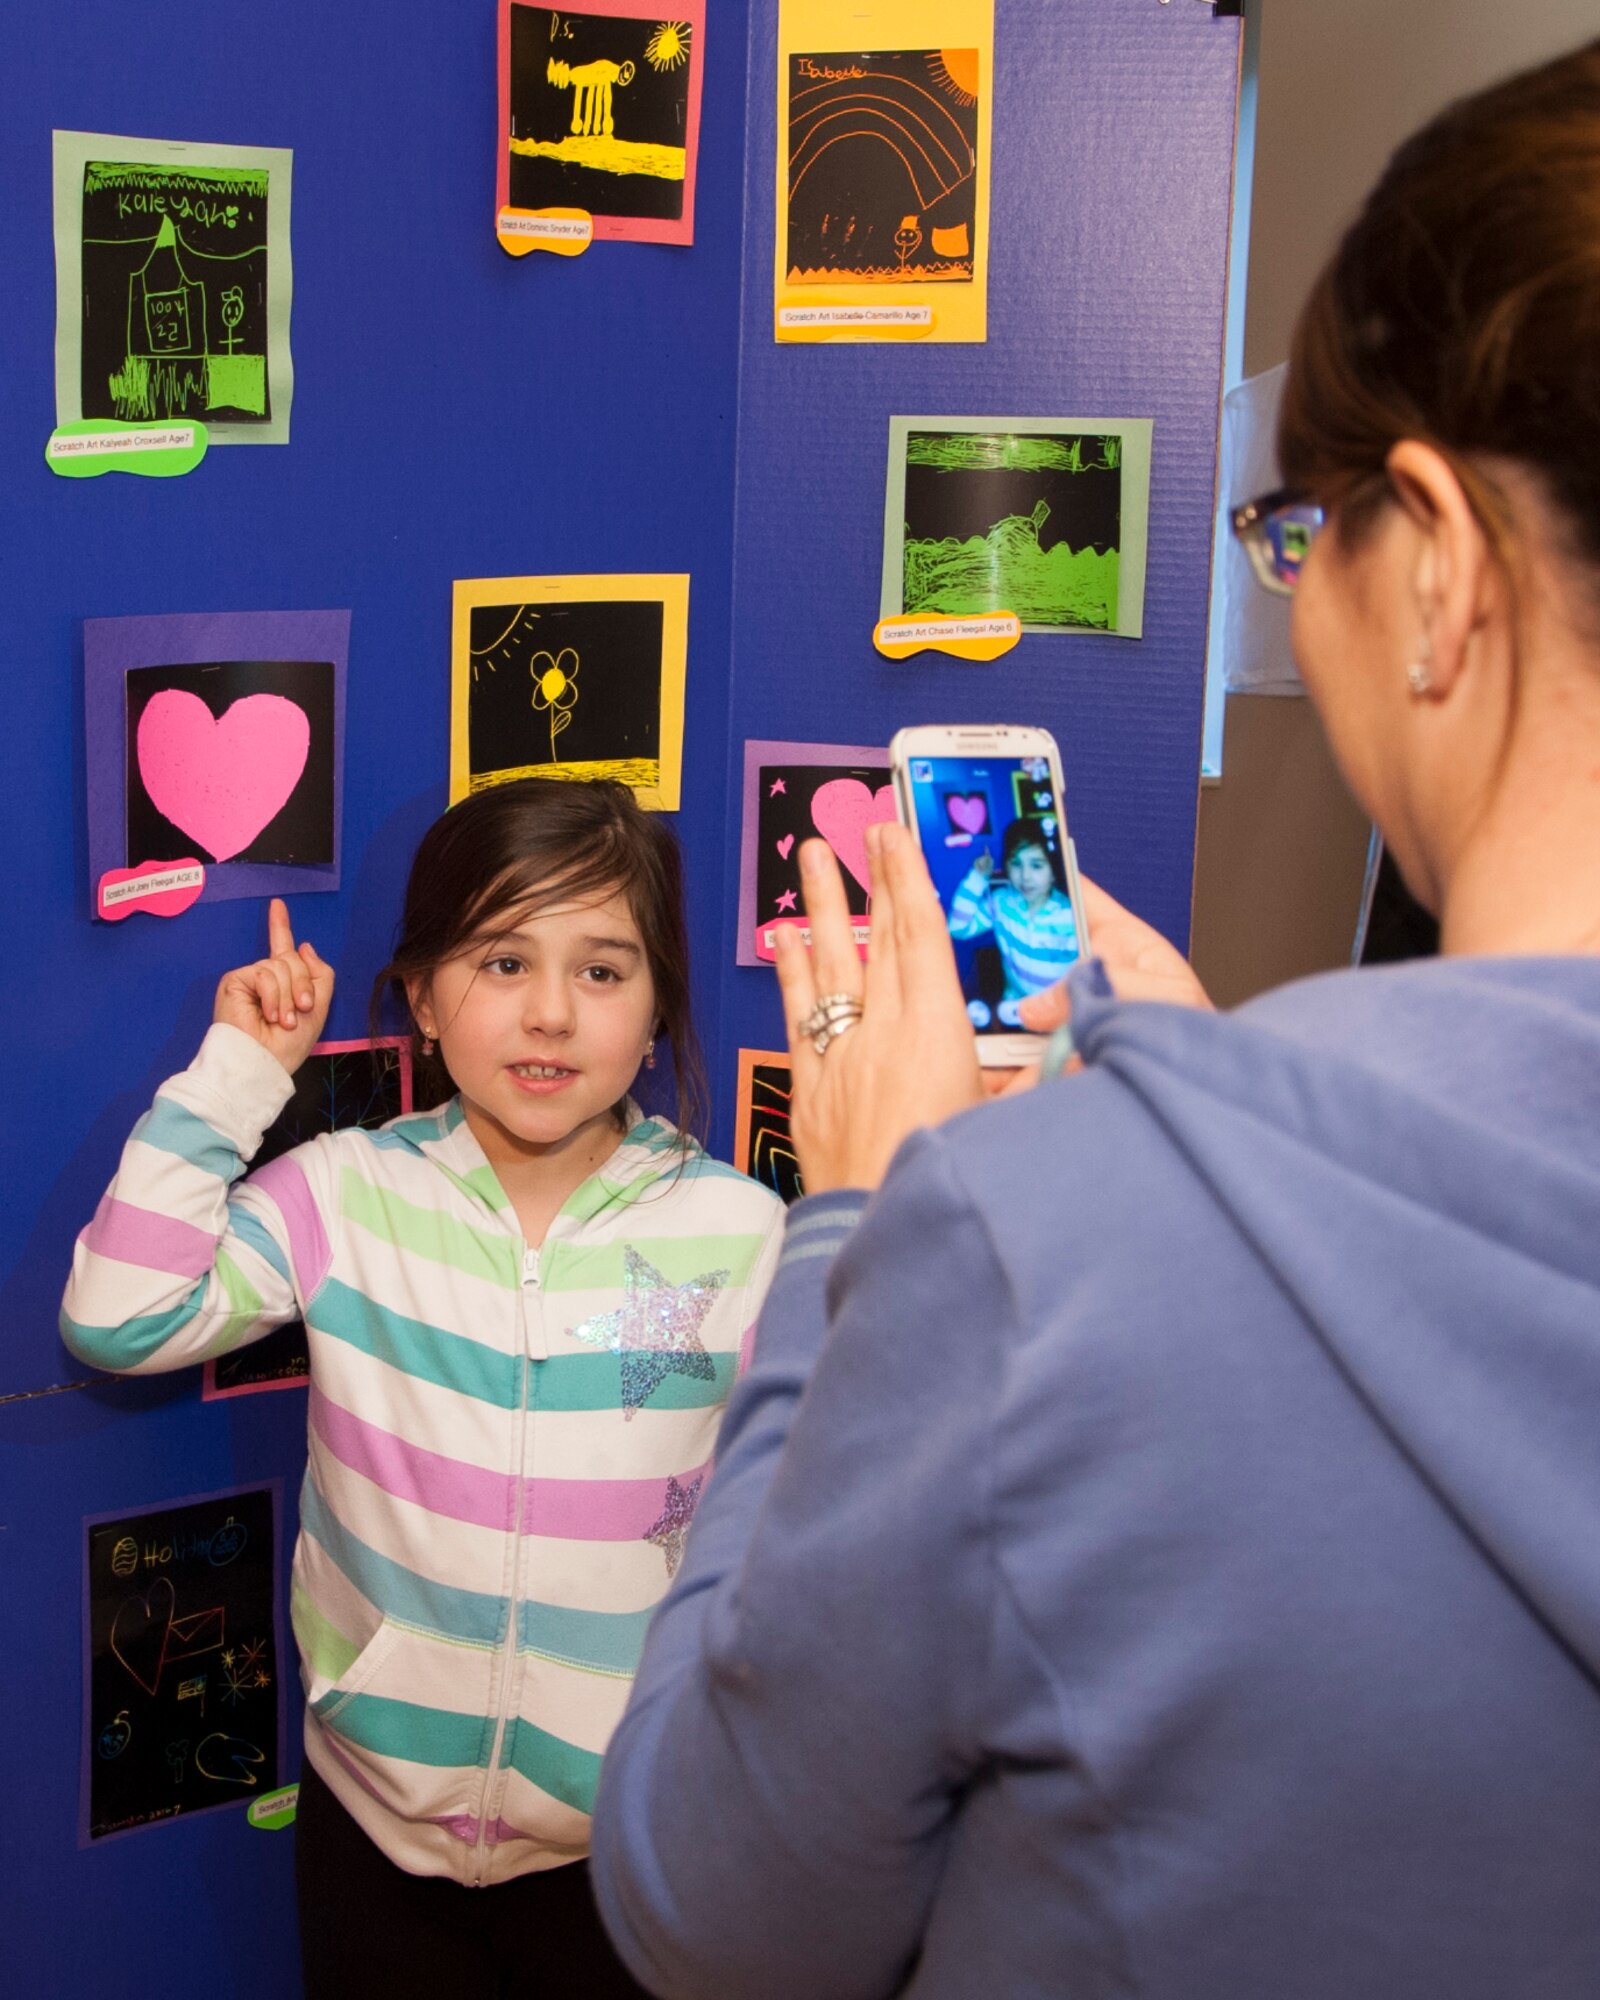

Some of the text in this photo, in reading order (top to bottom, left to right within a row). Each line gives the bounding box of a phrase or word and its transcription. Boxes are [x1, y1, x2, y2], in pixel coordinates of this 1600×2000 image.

[785, 312, 817, 322] Scratch
[818, 312, 830, 321] Art
[905, 310, 921, 321] Age
[922, 310, 928, 319] 7
[53, 442, 85, 453] Scratch
[87, 439, 98, 449] Art
[884, 629, 913, 640] Scratch
[915, 628, 927, 636] Art
[928, 624, 954, 636] Chase
[988, 623, 1004, 633] Age
[1006, 622, 1012, 631] 6
[106, 887, 126, 900] Scratch
[127, 885, 136, 894] Art
